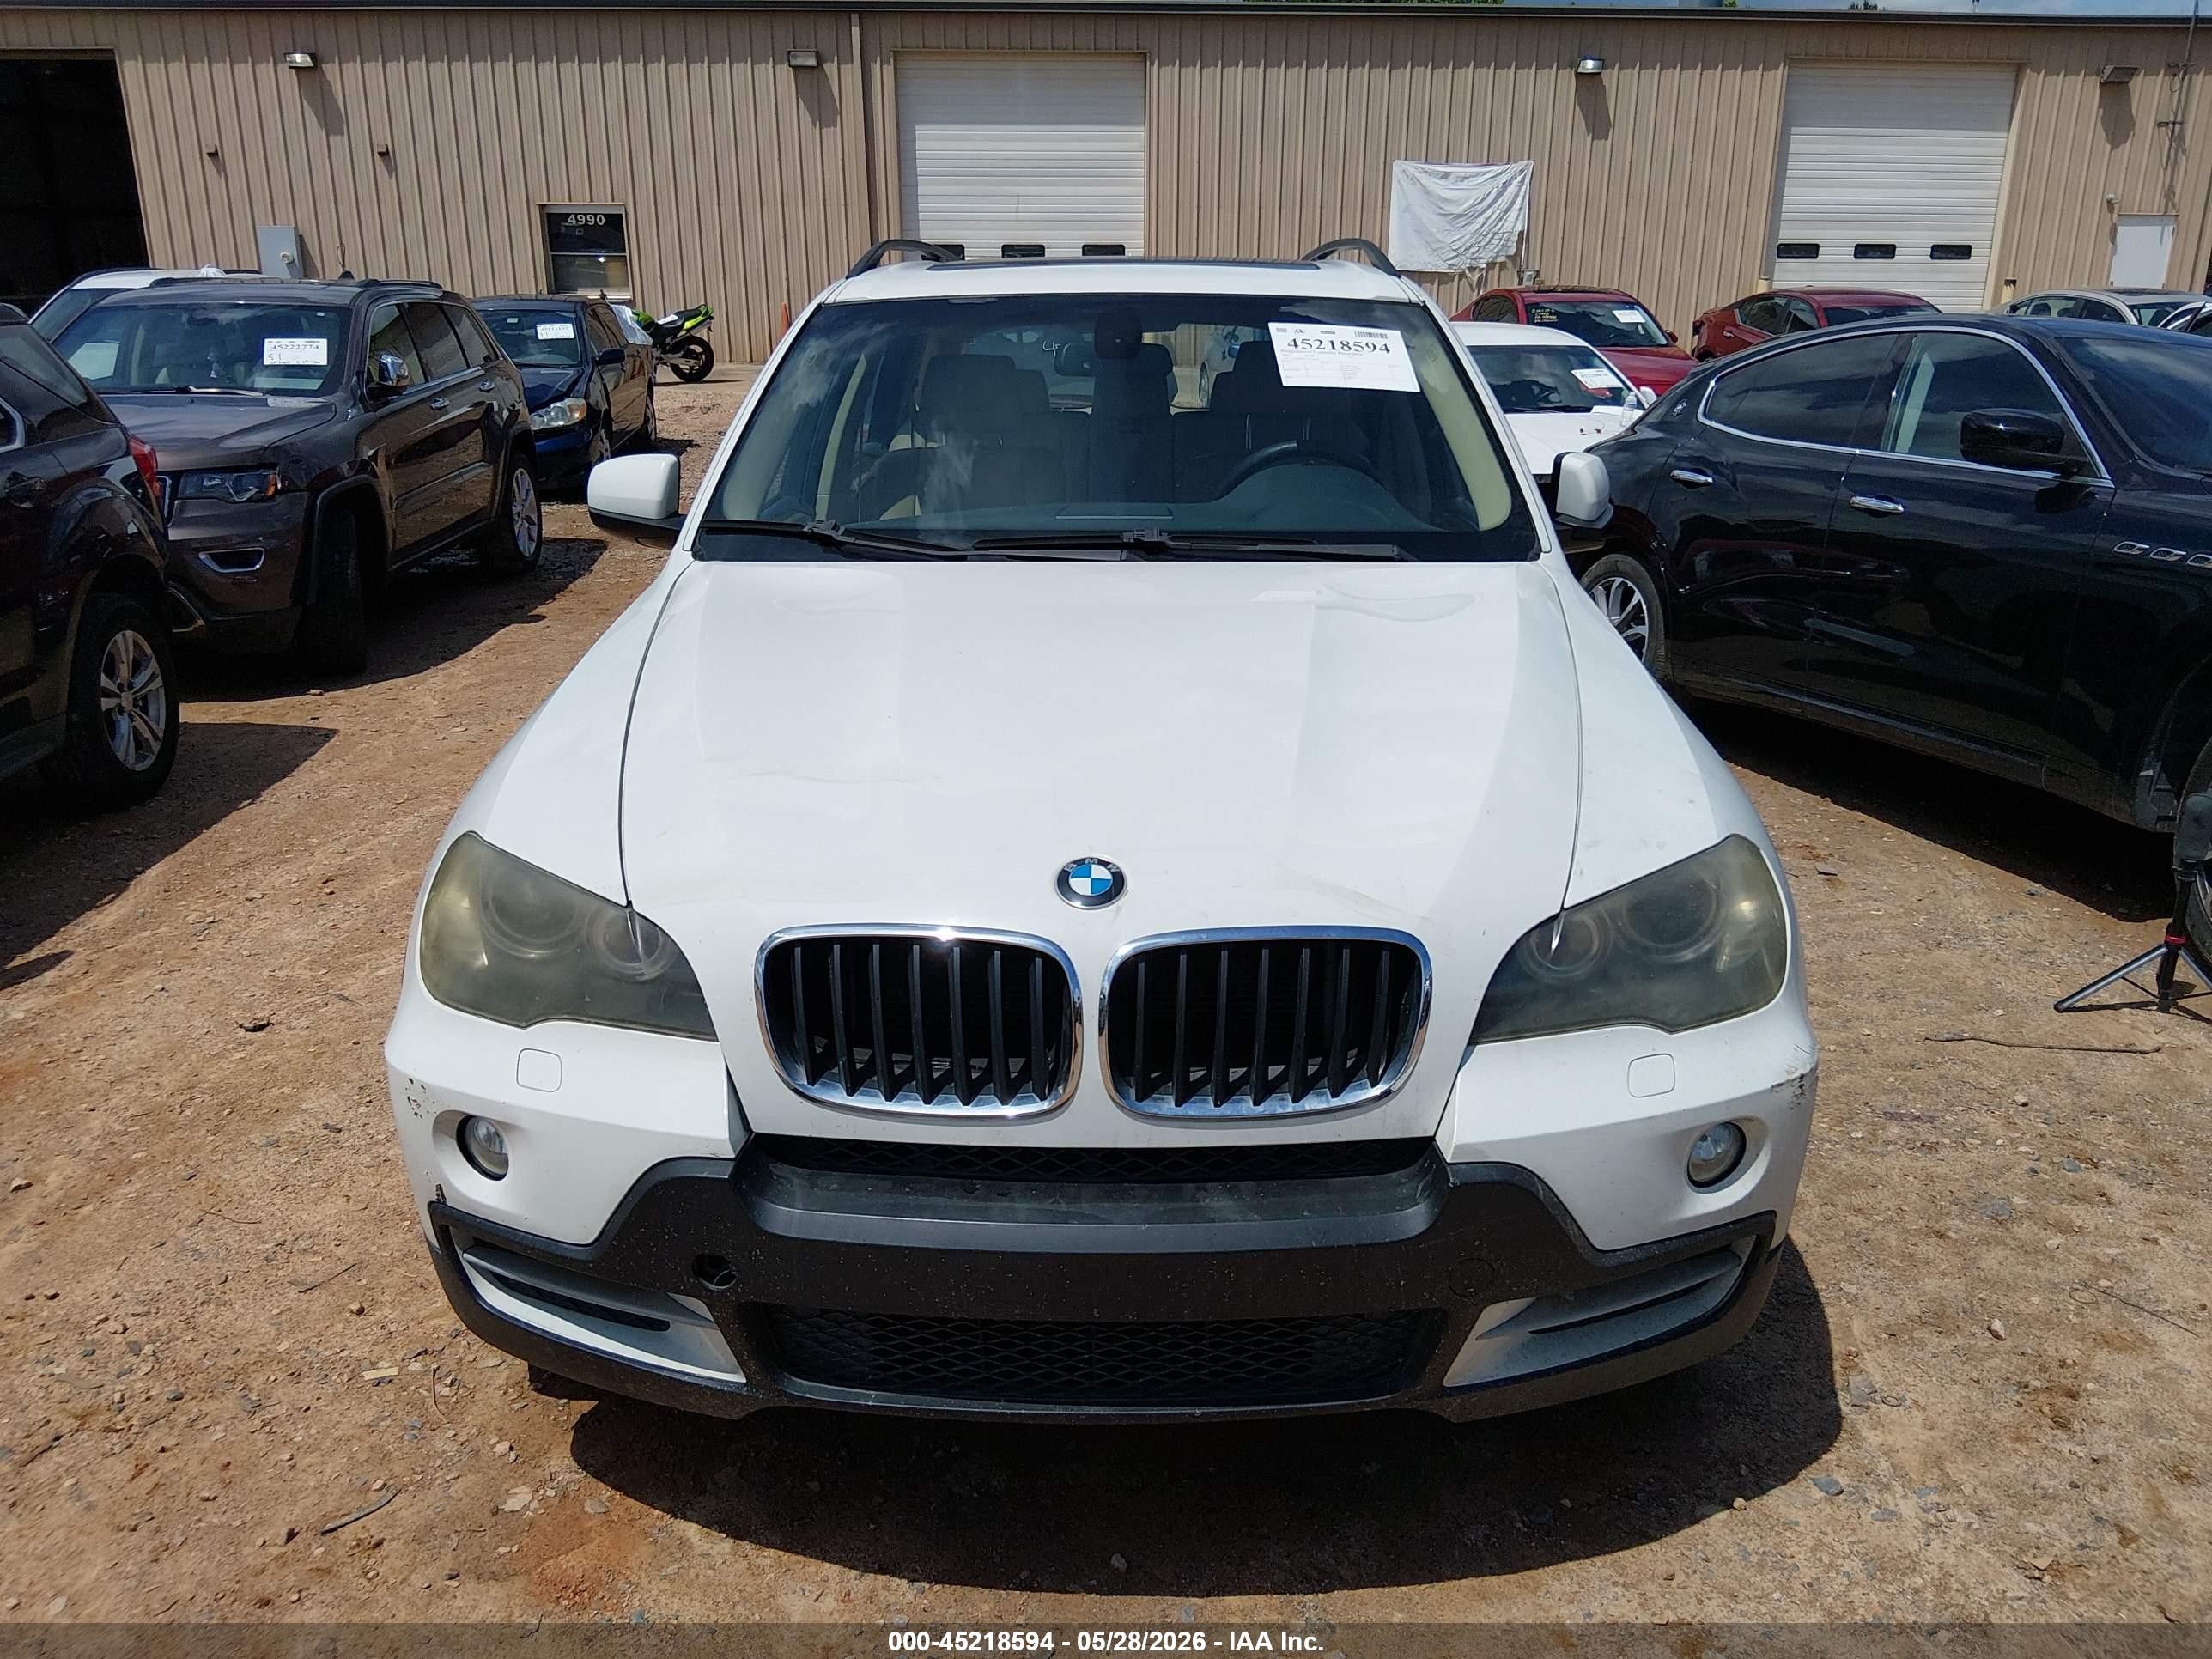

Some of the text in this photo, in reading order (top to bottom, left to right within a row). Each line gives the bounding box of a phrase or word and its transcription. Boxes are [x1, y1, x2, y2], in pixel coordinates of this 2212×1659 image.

[568, 214, 605, 226] 4990
[1287, 337, 1391, 354] 45218594
[1063, 858, 1120, 872] BMW
